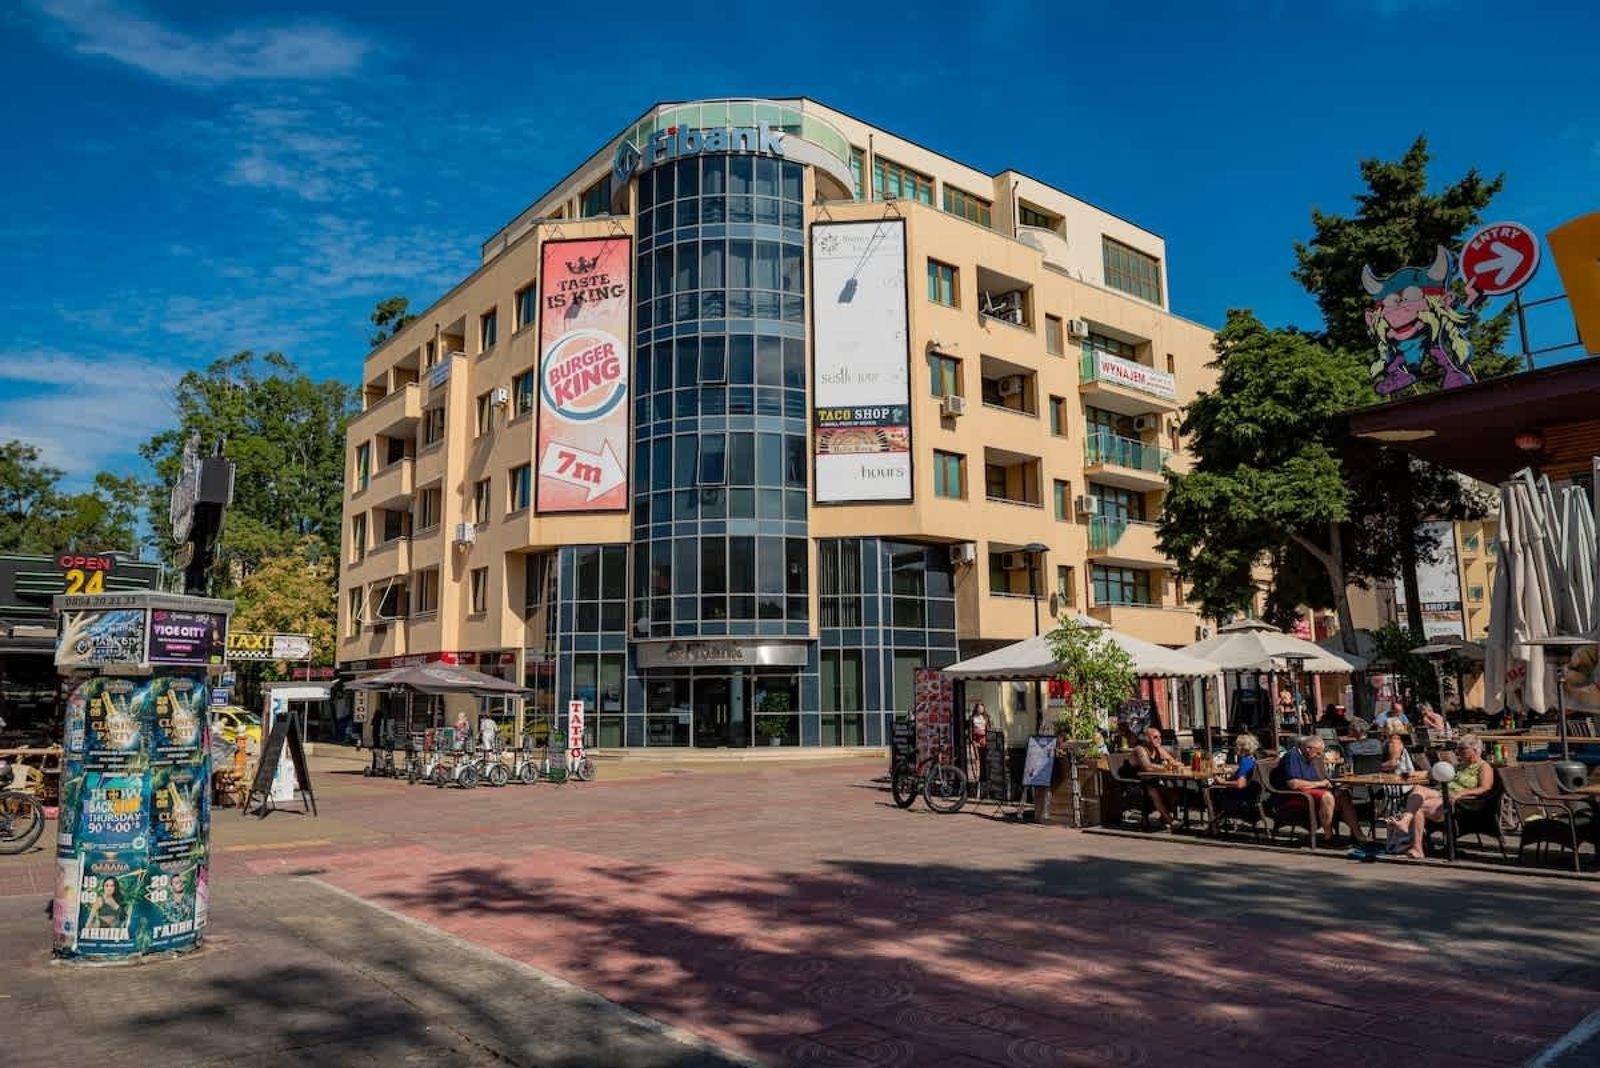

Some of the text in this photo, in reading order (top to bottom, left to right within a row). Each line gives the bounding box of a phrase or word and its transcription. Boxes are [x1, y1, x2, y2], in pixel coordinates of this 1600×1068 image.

[649, 120, 786, 165] Fibank
[1471, 227, 1523, 251] ENTRY
[558, 274, 610, 292] TASTE
[547, 284, 625, 309] IS KING
[549, 343, 616, 386] BURGER
[1102, 361, 1147, 385] WYNAJEM
[554, 357, 621, 407] KING
[818, 408, 890, 421] TACO SHOP
[556, 450, 602, 484] 7m
[60, 555, 112, 570] OPEN
[66, 568, 105, 595] 24
[180, 626, 207, 638] CITY
[228, 633, 270, 649] TAXI
[89, 812, 141, 822] THURSDAY
[151, 874, 168, 888] 20
